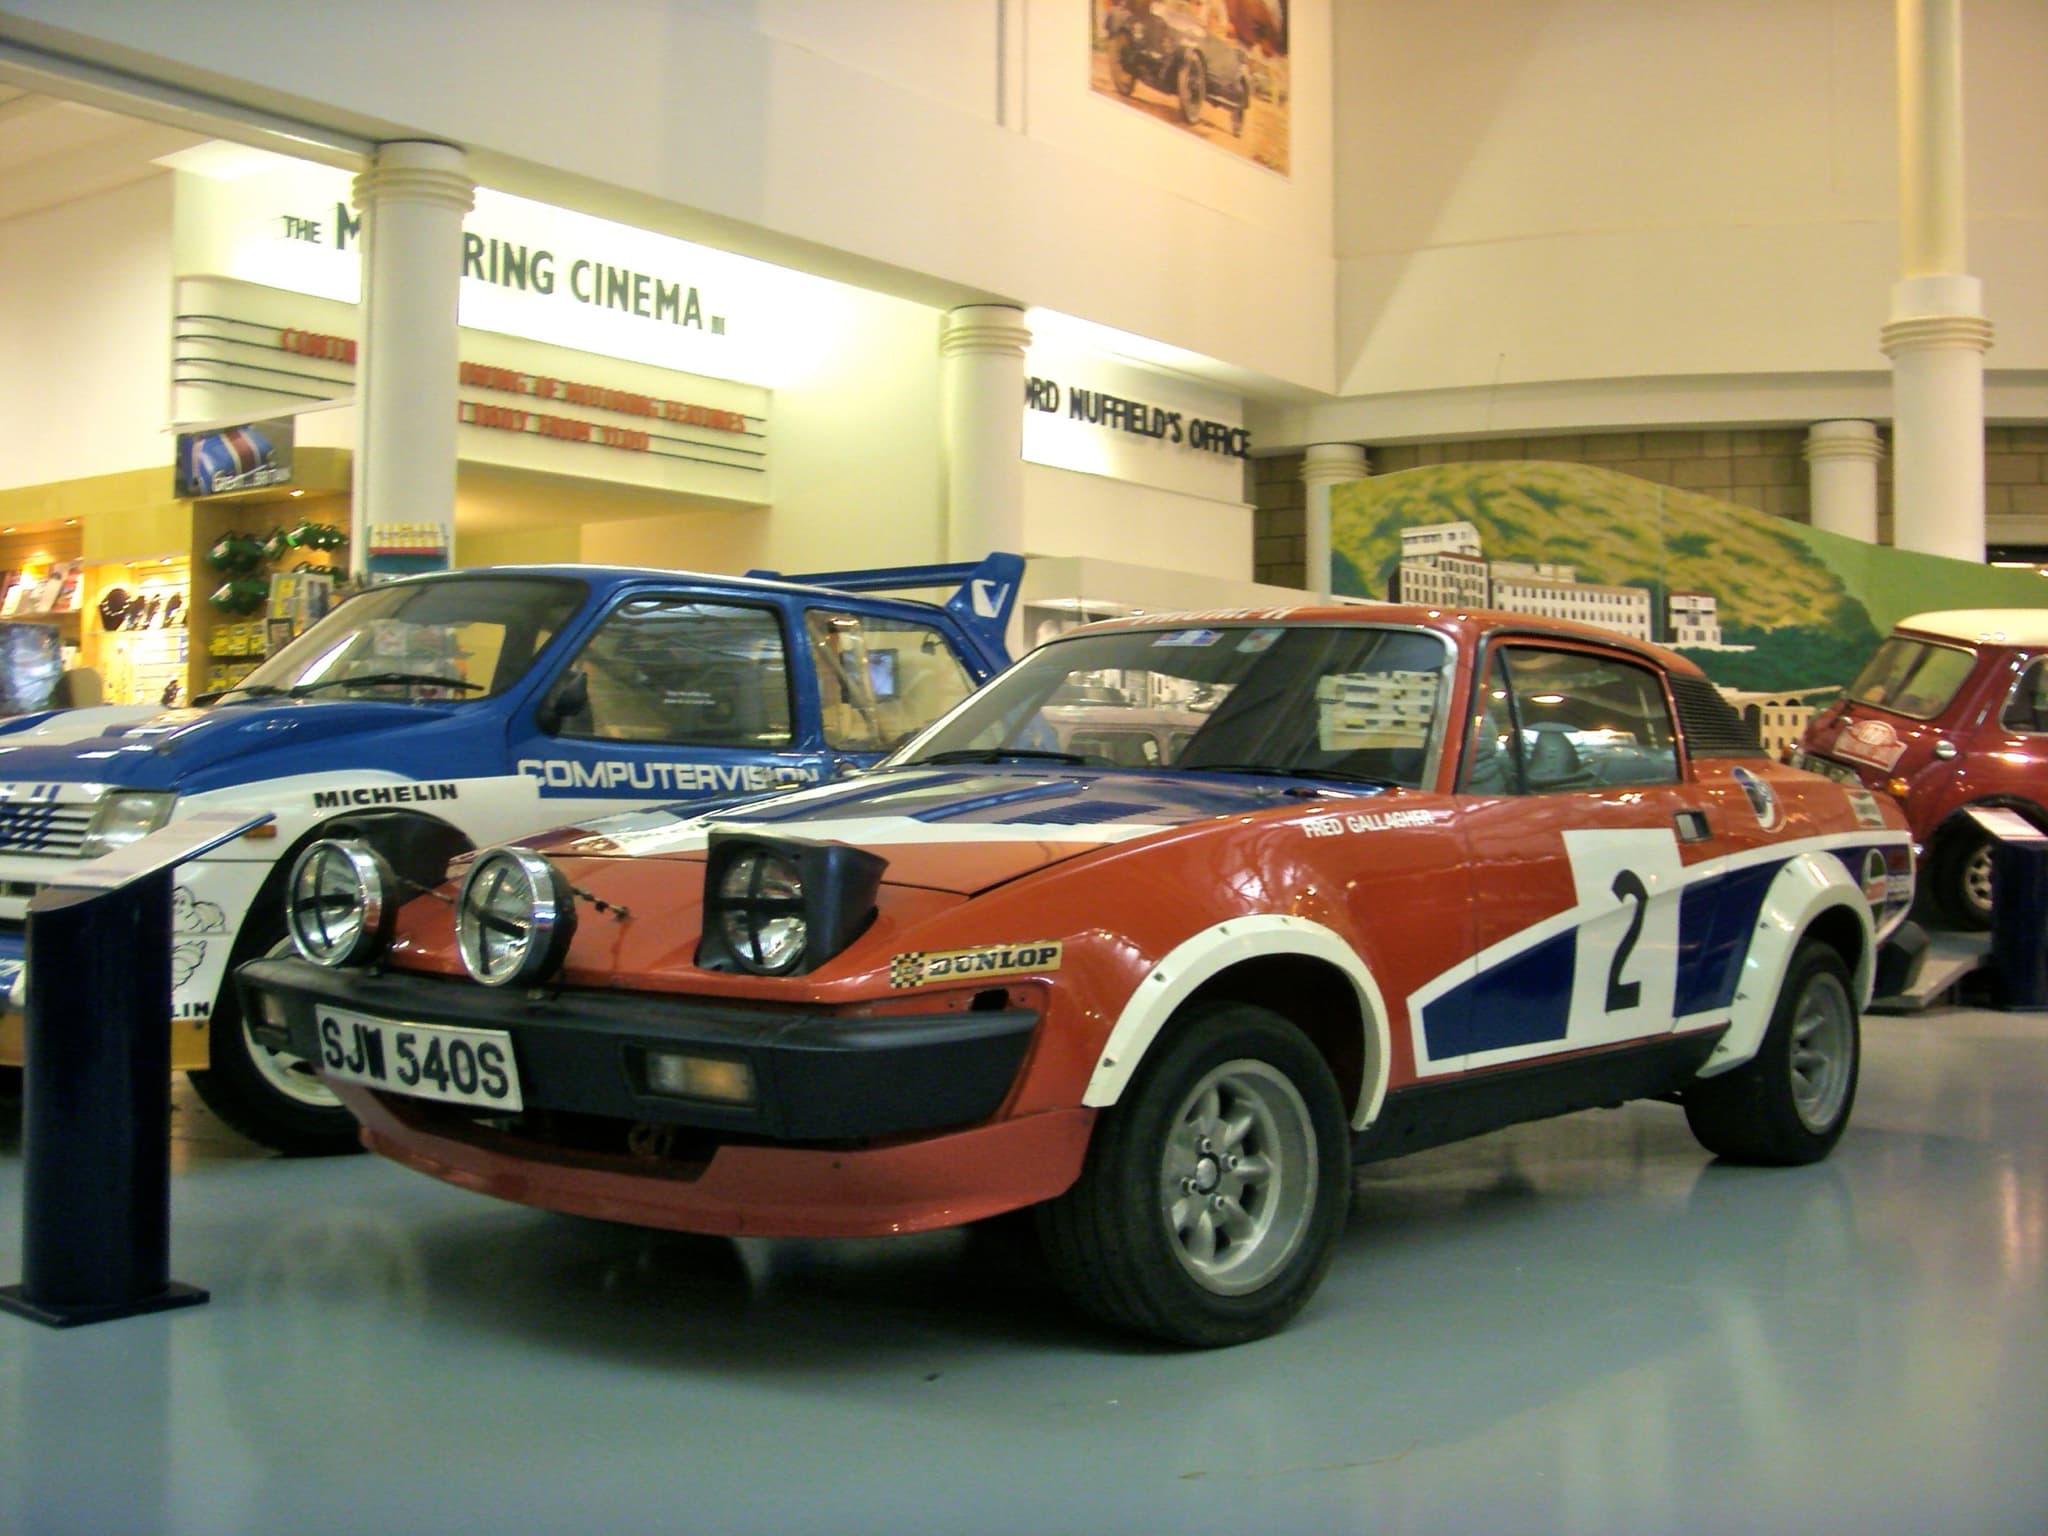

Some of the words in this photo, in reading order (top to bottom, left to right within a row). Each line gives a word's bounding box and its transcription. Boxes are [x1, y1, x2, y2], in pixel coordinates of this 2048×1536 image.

[282, 214, 322, 244] THE
[570, 258, 703, 330] CINEMA
[1024, 376, 1060, 413] RD
[1069, 386, 1183, 443] NUFFIELD'S
[1189, 417, 1252, 461] OFFICE
[314, 783, 458, 809] MICHELIN
[517, 758, 819, 792] COMPUTERVISION
[1302, 818, 1344, 838] FRED
[1347, 809, 1434, 833] GALLAGHER
[928, 947, 1057, 976] DUNLOP
[1604, 868, 1649, 1013] 2
[396, 1032, 509, 1099] 540S
